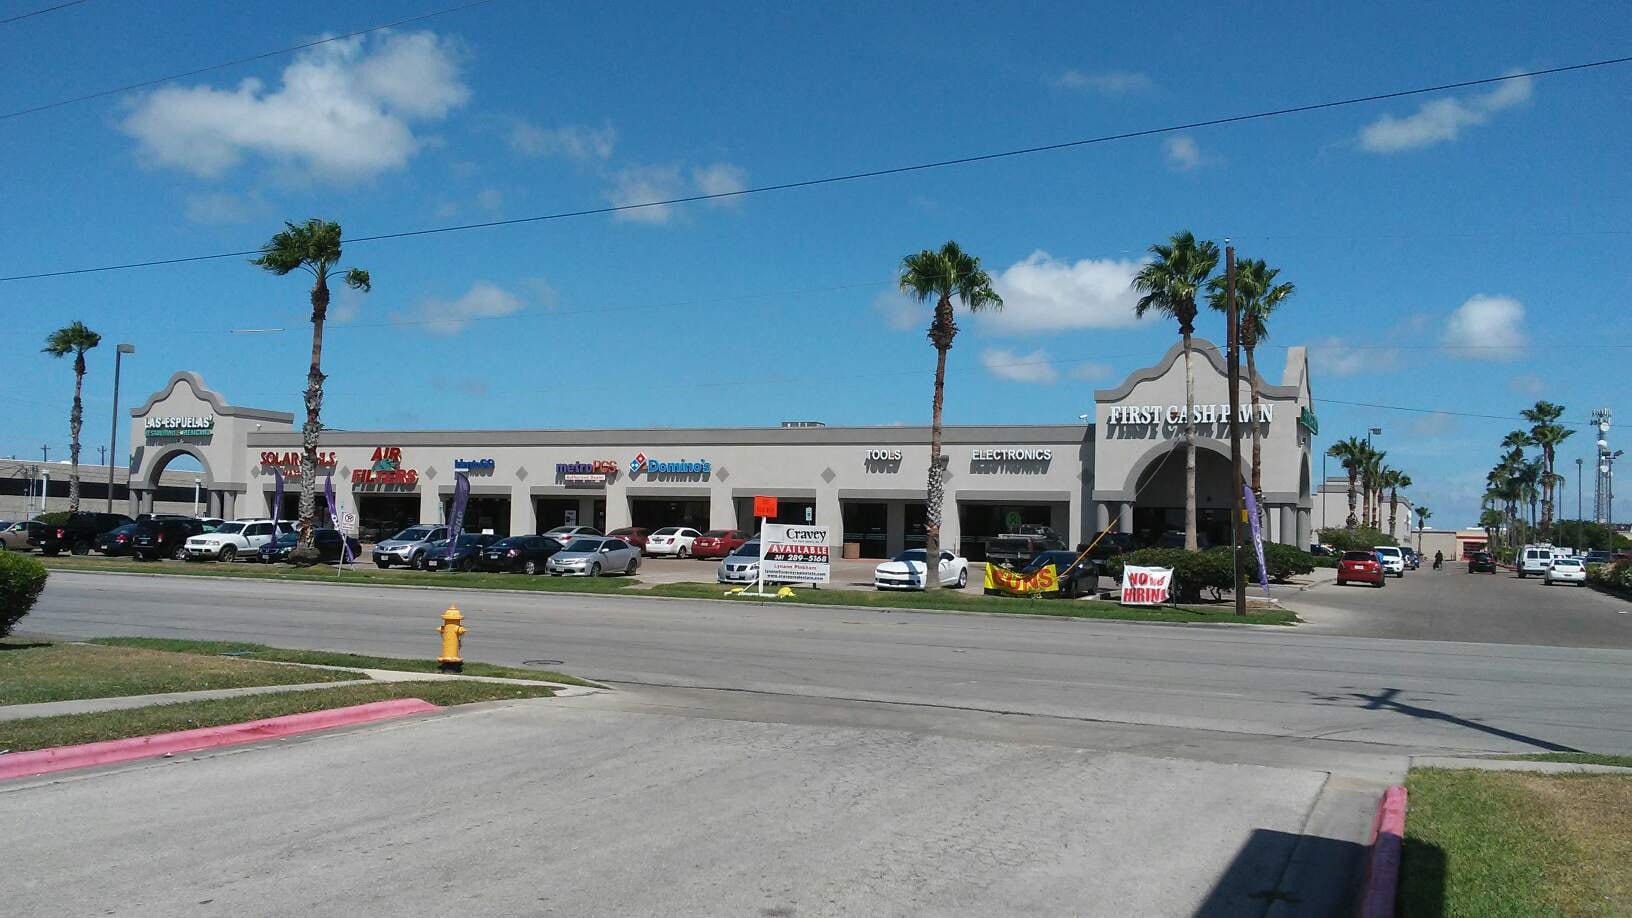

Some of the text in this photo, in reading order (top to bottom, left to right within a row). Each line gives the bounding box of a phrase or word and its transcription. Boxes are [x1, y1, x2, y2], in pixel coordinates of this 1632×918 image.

[1109, 404, 1161, 425] FIRST
[1166, 404, 1217, 424] CASH
[260, 451, 301, 466] SOLAR
[370, 447, 402, 461] AIR
[866, 450, 901, 460] TOOLS
[972, 449, 1051, 460] ELECTRONICS
[555, 460, 618, 473] metroPCS
[647, 459, 711, 473] Domino's
[351, 469, 418, 484] FILTERS
[786, 528, 826, 543] Cravey
[772, 545, 827, 554] AVAILABLE
